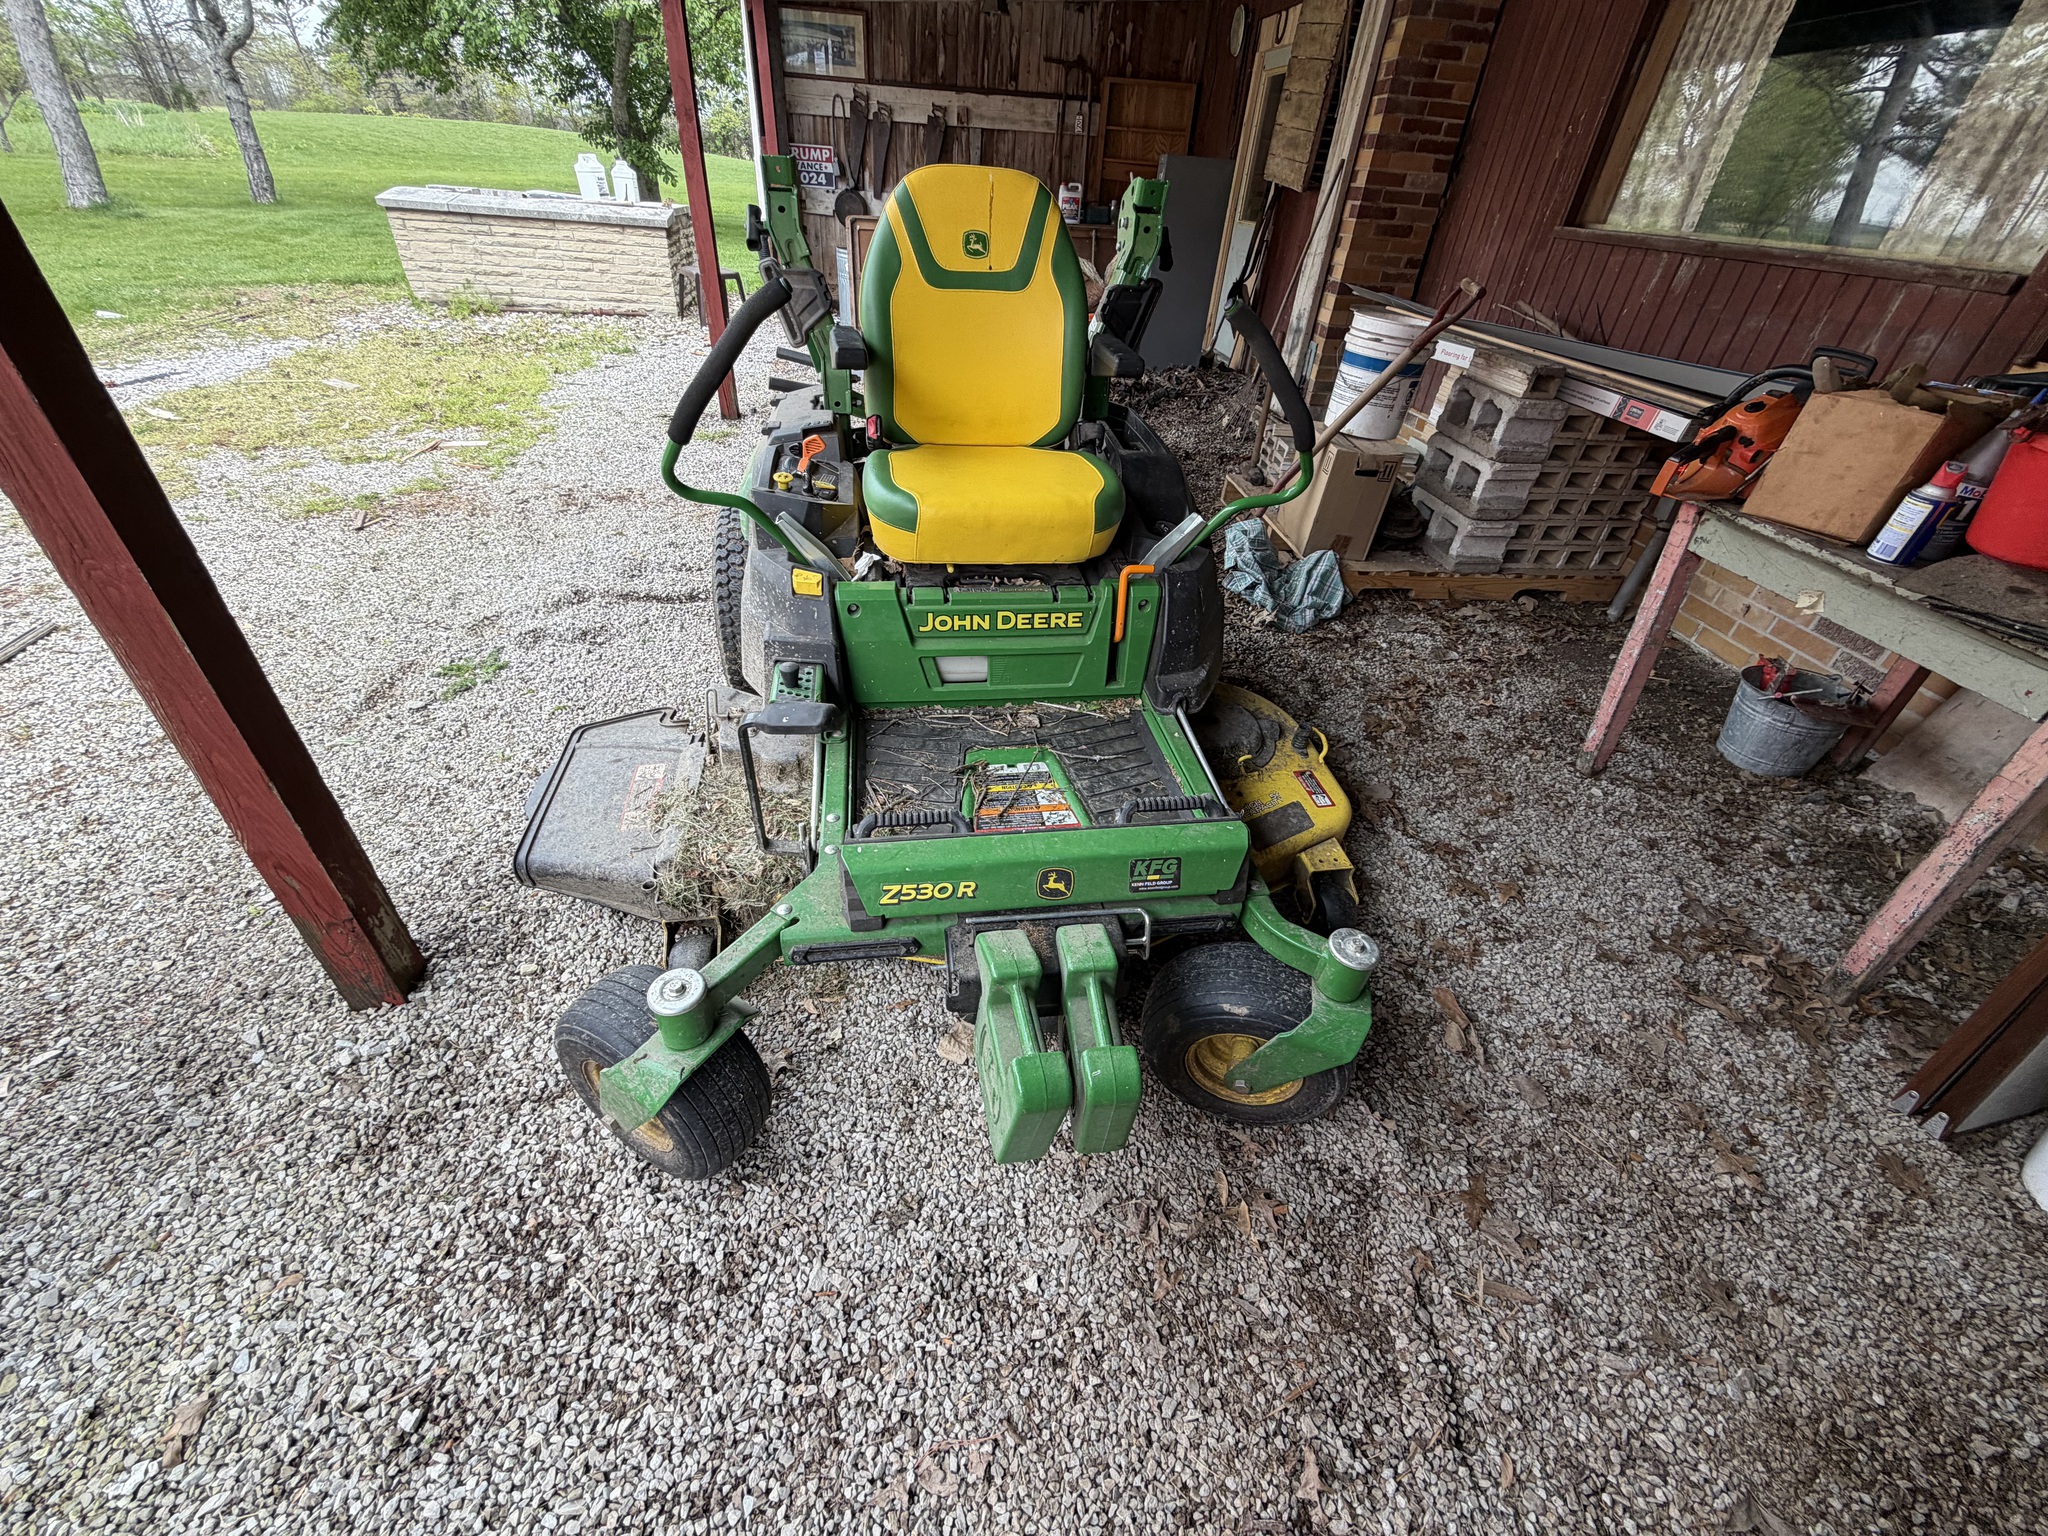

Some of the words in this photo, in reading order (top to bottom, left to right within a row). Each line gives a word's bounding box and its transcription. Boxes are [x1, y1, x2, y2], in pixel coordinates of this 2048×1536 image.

[790, 146, 831, 161] RUMP
[799, 162, 824, 171] ANCE
[800, 171, 827, 186] 024
[1440, 348, 1461, 361] Flooring
[918, 612, 991, 632] JOHN
[996, 610, 1083, 630] DEERE
[1133, 859, 1179, 876] KFG
